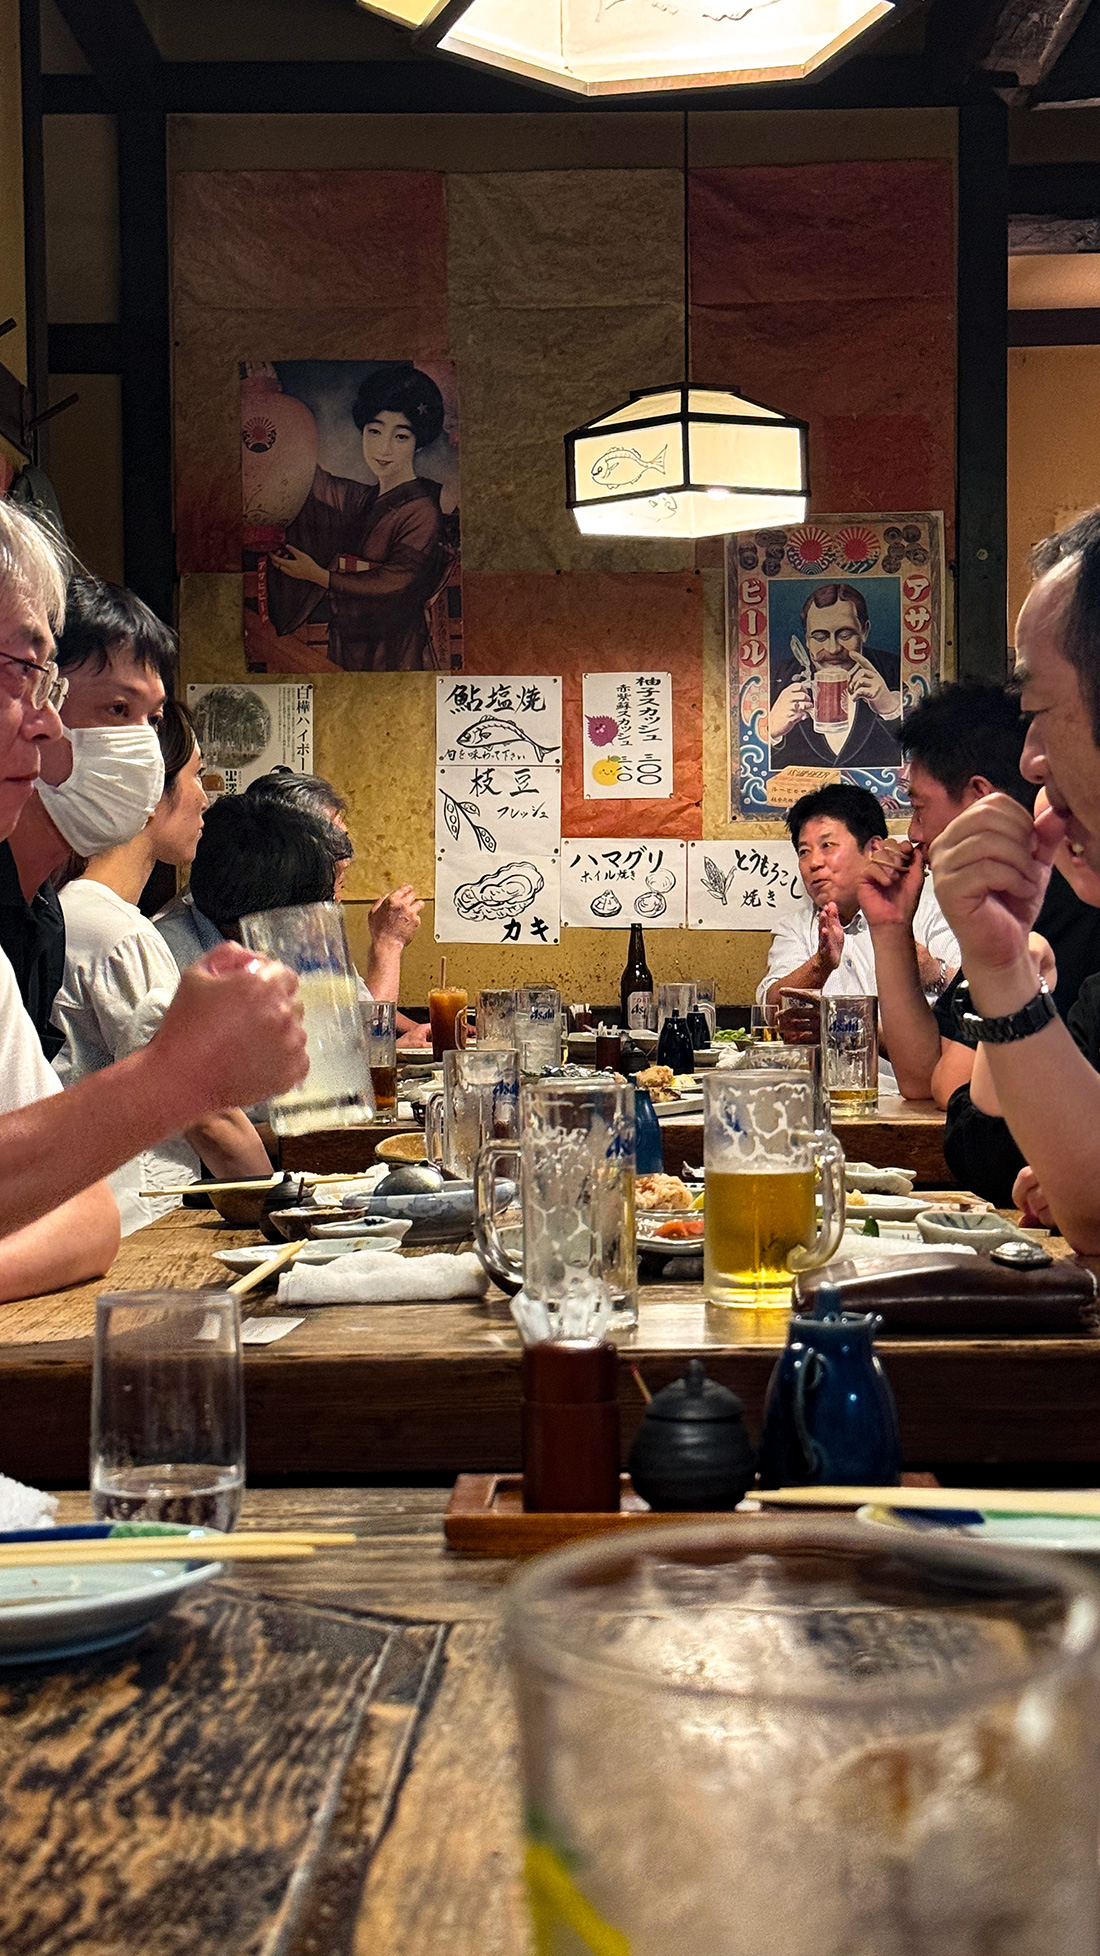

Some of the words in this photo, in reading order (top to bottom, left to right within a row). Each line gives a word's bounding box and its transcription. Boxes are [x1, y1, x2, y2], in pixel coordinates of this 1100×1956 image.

[740, 579, 766, 666] ビール
[904, 576, 930, 663] アサヒ
[445, 684, 546, 714] 鮎塩焼
[636, 677, 662, 741] 柚子スカッシュ
[296, 685, 310, 775] 白樺ハイボー
[469, 768, 539, 797] 枝豆
[616, 755, 633, 781] 三八〇
[637, 753, 662, 785] 三〇〇
[497, 802, 549, 819] フレッシュ
[569, 845, 664, 874] ハマグリ
[735, 849, 804, 899] とうもろこし
[580, 870, 636, 883] ホイル焼き
[740, 889, 776, 908] 焼き
[502, 917, 550, 942] カキ
